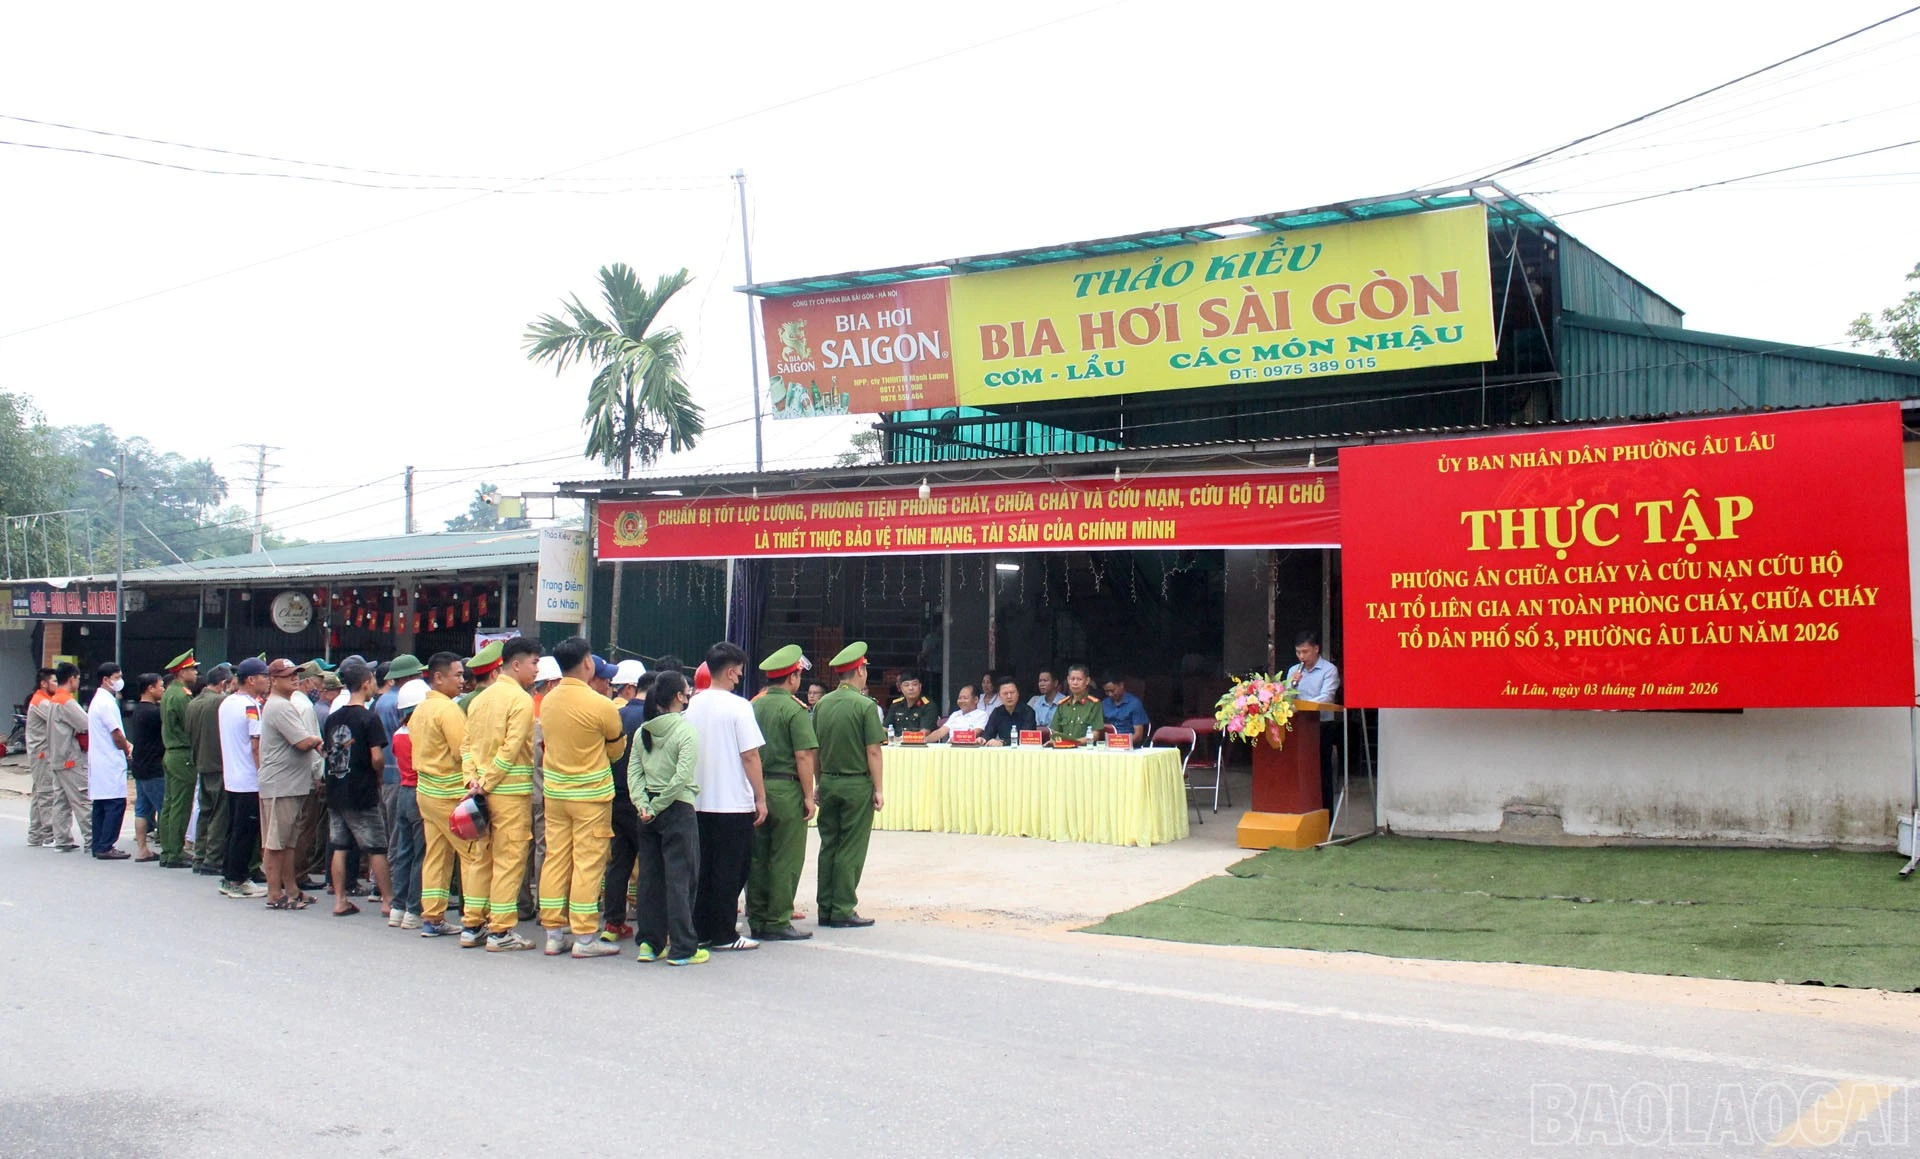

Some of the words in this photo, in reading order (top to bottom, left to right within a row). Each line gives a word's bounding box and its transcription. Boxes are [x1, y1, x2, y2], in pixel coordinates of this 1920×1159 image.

[1073, 256, 1194, 298] THẢO
[1205, 236, 1322, 283] KIỀU
[835, 312, 871, 333] BIA
[877, 307, 913, 329] HƠI
[979, 318, 1066, 361] BIA
[1078, 302, 1181, 351] HƠI
[1199, 285, 1292, 338] SÀI
[1311, 269, 1460, 326] GÒN
[1169, 346, 1241, 369] CÁC
[1252, 337, 1335, 363] MÓN
[1347, 324, 1464, 354] NHẬU
[777, 361, 816, 374] SAIGON
[983, 367, 1043, 388] CƠM
[1066, 353, 1125, 381] LẨU
[1229, 366, 1257, 381] ĐT:
[1263, 362, 1303, 378] 0975
[1309, 359, 1340, 374] 389
[1345, 356, 1377, 371] 015
[1437, 453, 1461, 473] ỦY
[1467, 454, 1504, 472] BAN
[1509, 448, 1562, 469] NHÂN
[1567, 444, 1607, 464] DÂN
[1613, 439, 1697, 461] PHƯỜNG
[1701, 435, 1729, 455] ÂU
[1734, 431, 1776, 453] LÂU
[658, 503, 696, 525] CHUẨN
[699, 508, 711, 527] BỊ
[714, 501, 735, 523] TỐT
[737, 504, 760, 526] LỰC
[763, 503, 807, 524] LƯỢNG,
[811, 500, 864, 519] PHƯƠNG
[867, 497, 897, 521] TIỆN
[951, 492, 990, 515] CHÁY,
[995, 490, 1034, 513] CHỮA
[1039, 488, 1079, 511] CHÁY
[1083, 487, 1103, 509] VÀ
[1108, 485, 1141, 509] CỨU
[1145, 488, 1184, 511] NẠN,
[1190, 484, 1223, 507] CỨU
[1228, 482, 1252, 509] HỘ
[1256, 484, 1284, 509] TẠI
[1289, 477, 1326, 504] CHỖ
[755, 530, 769, 549] LÀ
[773, 526, 806, 549] THIẾT
[809, 528, 842, 551] THỰC
[845, 524, 872, 547] BẢO
[875, 525, 891, 549] VỆ
[895, 522, 926, 545] TÍNH
[930, 525, 977, 548] MẠNG,
[981, 521, 1003, 543] TÀI
[1008, 518, 1039, 542] SẢN
[1043, 517, 1074, 541] CỦA
[1078, 518, 1127, 541] CHÍNH
[1131, 516, 1176, 539] MÌNH
[1460, 498, 1620, 561] THỰC
[1635, 488, 1754, 555] TẬP
[542, 579, 563, 592] Trang
[1391, 568, 1469, 589] PHƯƠNG
[1473, 565, 1501, 586] ÁN
[1505, 564, 1559, 586] CHỮA
[1564, 562, 1620, 584] CHÁY
[1625, 559, 1653, 582] VÀ
[1658, 558, 1702, 581] CỨU
[1708, 558, 1752, 582] NẠN
[1758, 553, 1805, 577] CỨU
[1810, 550, 1843, 578] HỘ
[1366, 602, 1396, 623] TẠI
[1401, 594, 1426, 618] TỔ
[1430, 597, 1472, 618] LIÊN
[1477, 600, 1512, 617] GIA
[1516, 599, 1543, 617] AN
[1548, 593, 1602, 616] TOÀN
[1608, 590, 1680, 615] PHÒNG
[1685, 588, 1748, 614] CHÁY,
[1751, 585, 1814, 609] CHỮA
[1818, 584, 1880, 607] CHÁY
[1398, 624, 1421, 649] TỔ
[1427, 627, 1466, 649] DÂN
[1471, 623, 1509, 648] PHỐ
[1514, 623, 1539, 648] SỐ
[1544, 630, 1560, 650] 3,
[1564, 625, 1652, 647] PHƯỜNG
[1657, 623, 1685, 646] ÂU
[1691, 621, 1733, 645] LÂU
[1738, 620, 1789, 643] NĂM
[1794, 622, 1840, 642] 2026
[1501, 681, 1518, 696] Âu
[1523, 682, 1549, 697] Lâu,
[1552, 684, 1580, 698] ngày
[1584, 683, 1598, 696] 03
[1601, 683, 1636, 698] tháng
[1640, 682, 1654, 696] 10
[1657, 683, 1685, 696] năm
[1689, 682, 1719, 695] 2026
